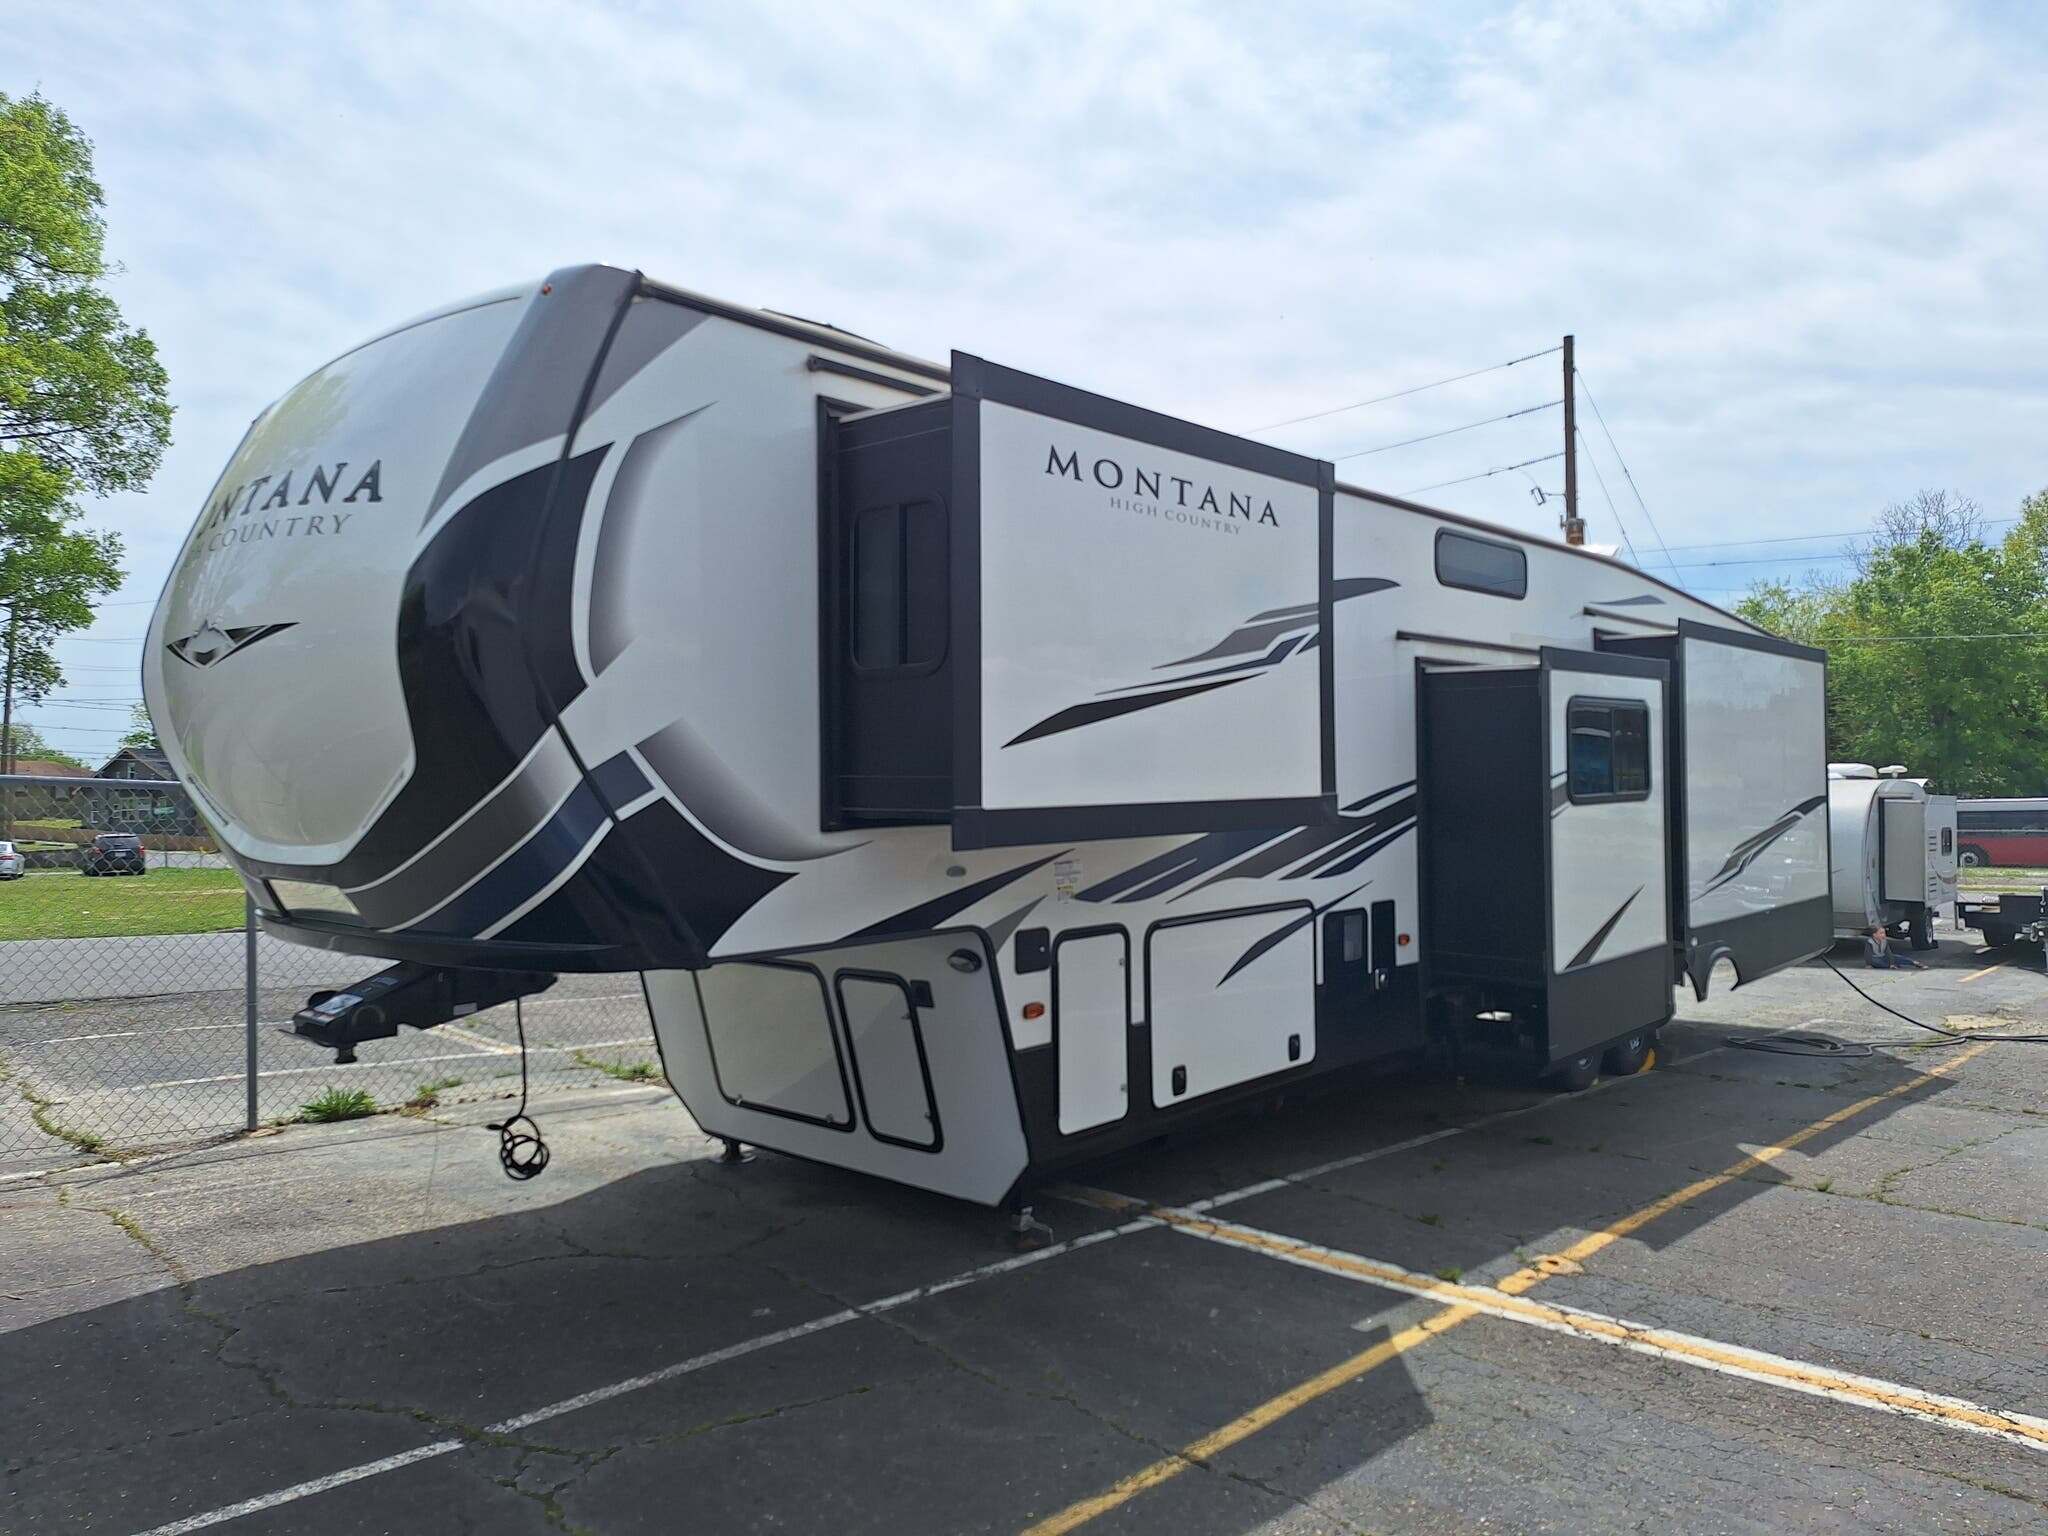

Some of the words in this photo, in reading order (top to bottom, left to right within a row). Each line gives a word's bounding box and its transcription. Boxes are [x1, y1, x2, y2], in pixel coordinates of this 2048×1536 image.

[197, 459, 384, 540] NTANA
[1045, 444, 1280, 528] MONTANA
[208, 513, 352, 552] COUNTRY
[1110, 497, 1158, 518] HIGH
[1164, 509, 1241, 536] COUNTRY
